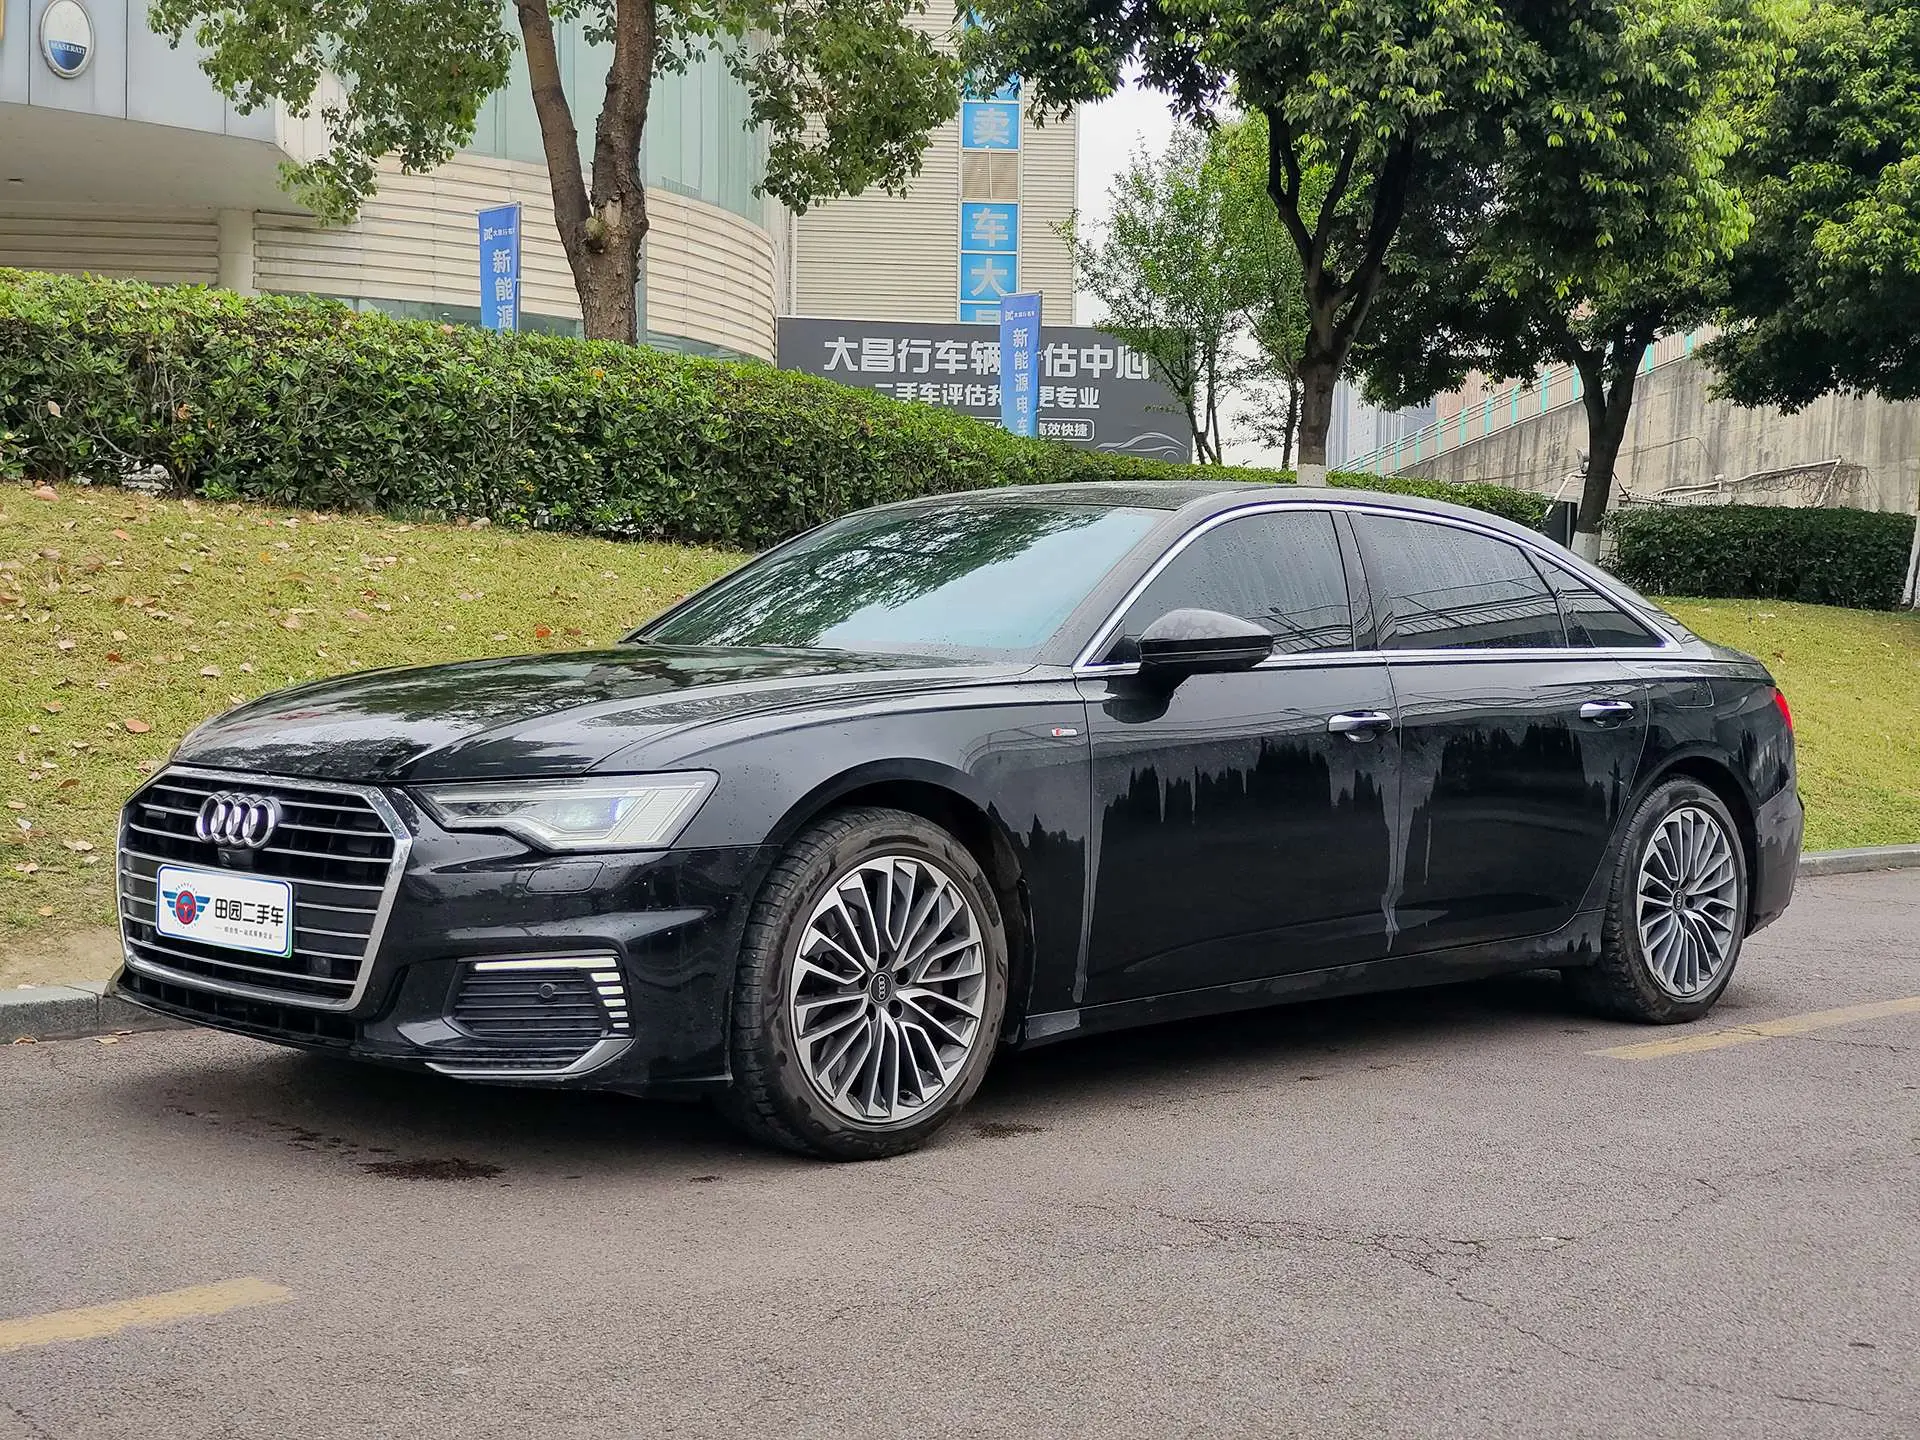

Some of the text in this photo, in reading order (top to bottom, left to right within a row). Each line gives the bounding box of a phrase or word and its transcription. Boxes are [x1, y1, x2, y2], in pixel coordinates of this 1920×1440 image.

[493, 249, 514, 329] 新能源
[823, 336, 1150, 380] 大昌行车辆估中心
[215, 898, 284, 927] 田园二手车
